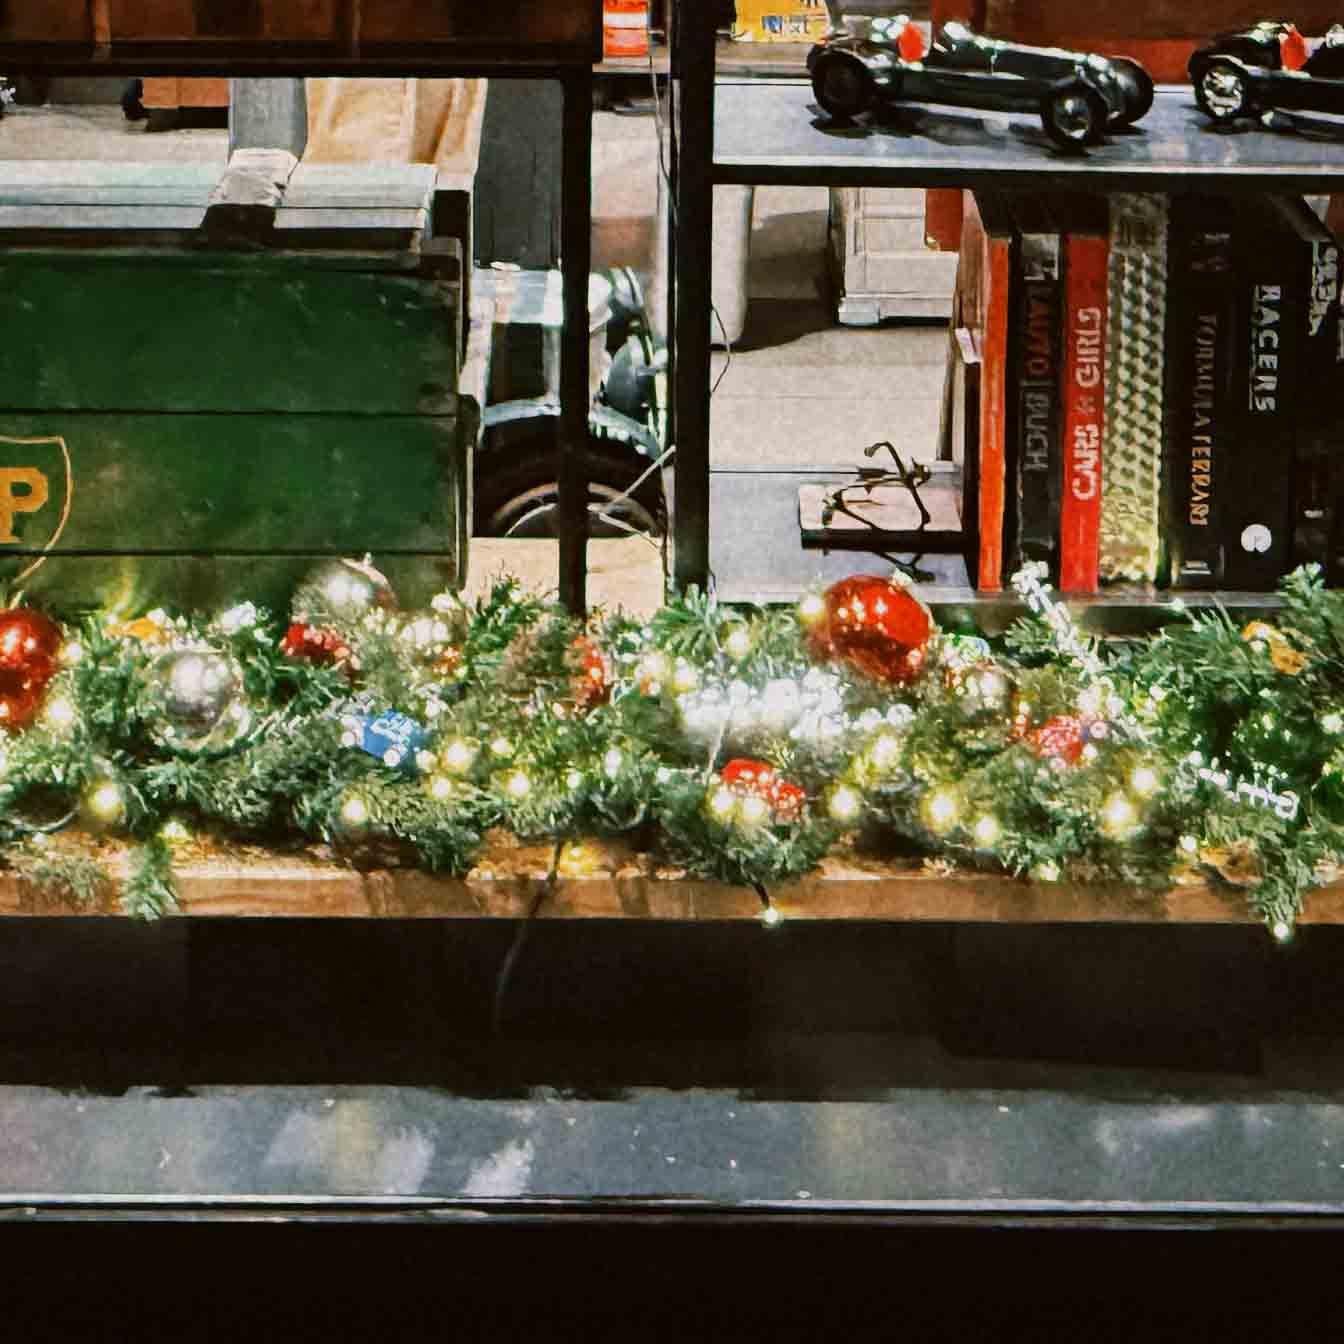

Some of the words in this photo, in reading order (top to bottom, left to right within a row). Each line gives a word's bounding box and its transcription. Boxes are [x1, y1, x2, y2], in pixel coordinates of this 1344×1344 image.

[1075, 307, 1102, 388] GIRLS
[1255, 284, 1282, 413] RACERS
[1072, 423, 1100, 501] CARS
